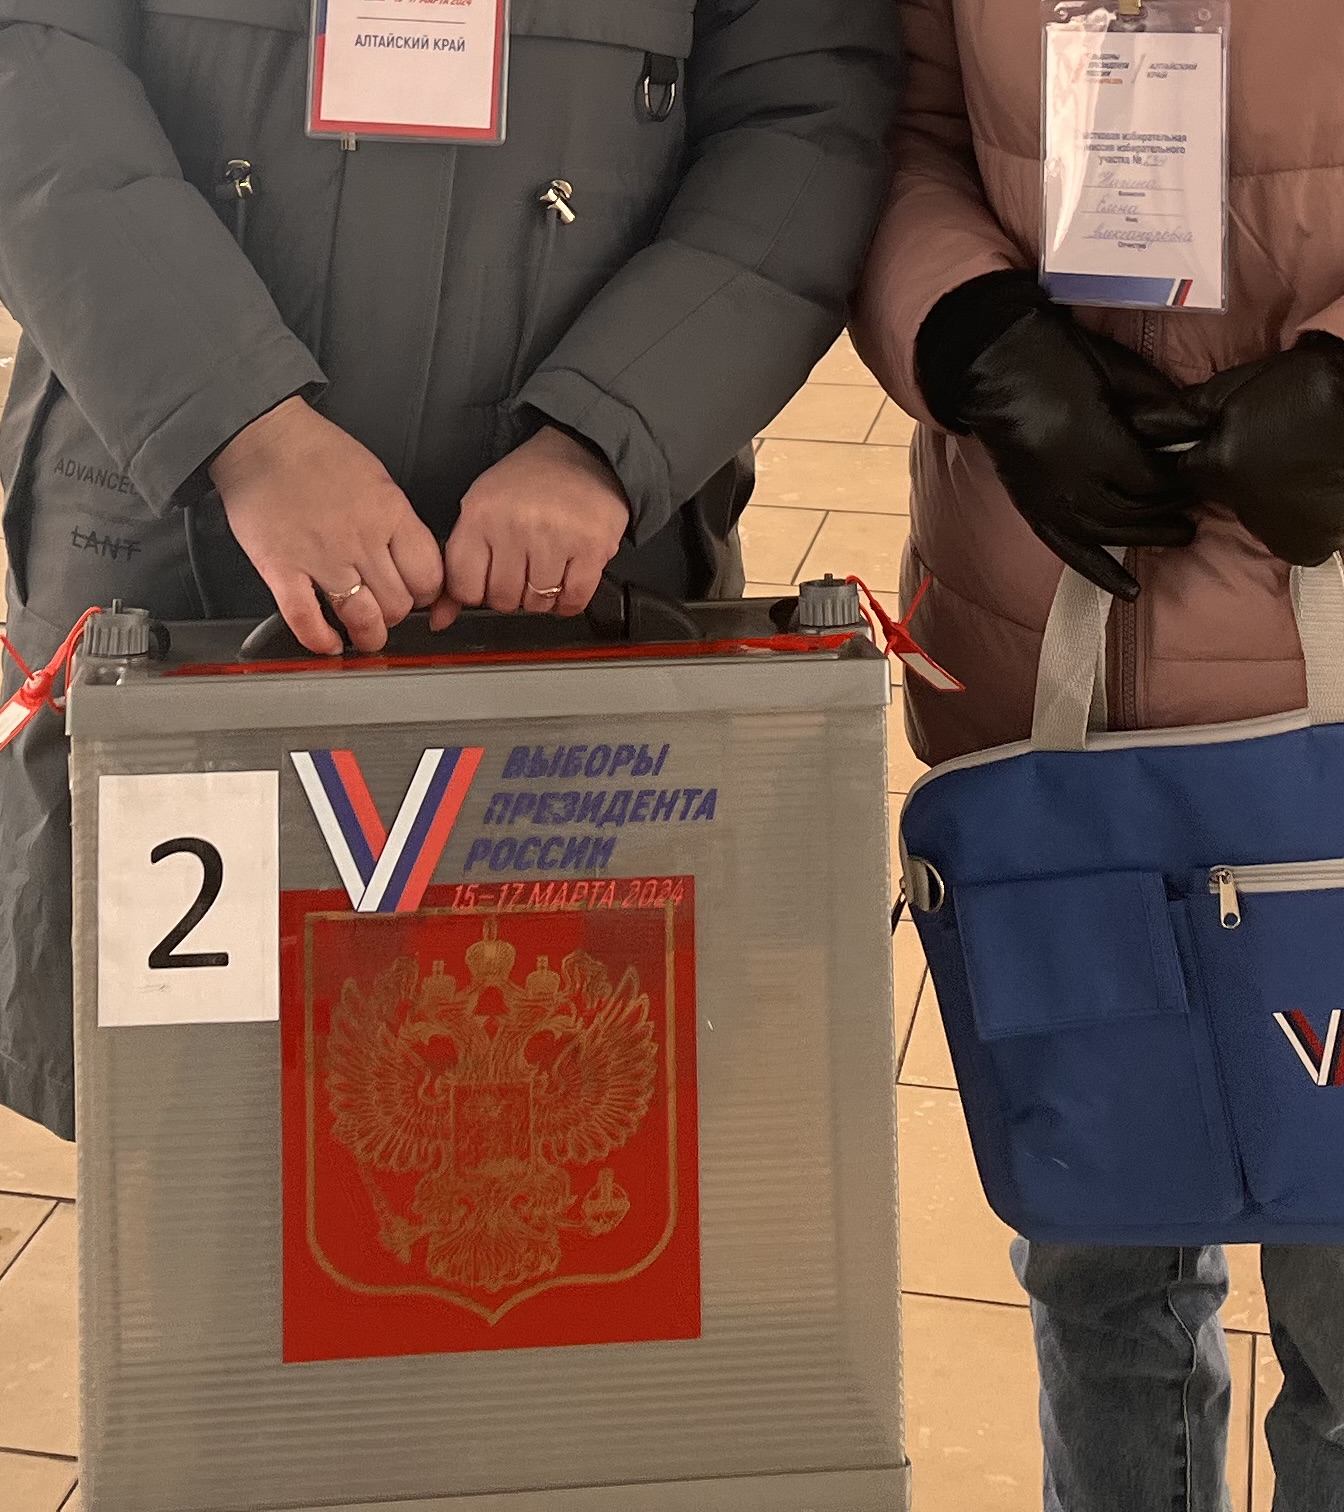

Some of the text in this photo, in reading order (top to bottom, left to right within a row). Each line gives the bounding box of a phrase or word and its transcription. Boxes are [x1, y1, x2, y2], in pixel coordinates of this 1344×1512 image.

[355, 32, 466, 53] АЛТАЙСКИЙ КРАЙ
[501, 743, 671, 779] ВЫБОРЫ
[482, 787, 718, 829] ПРЕЗИДЕНТА
[462, 835, 618, 873] РОССИИ
[147, 835, 229, 970] 2
[527, 880, 617, 909] МАРТА
[621, 878, 686, 909] 2024
